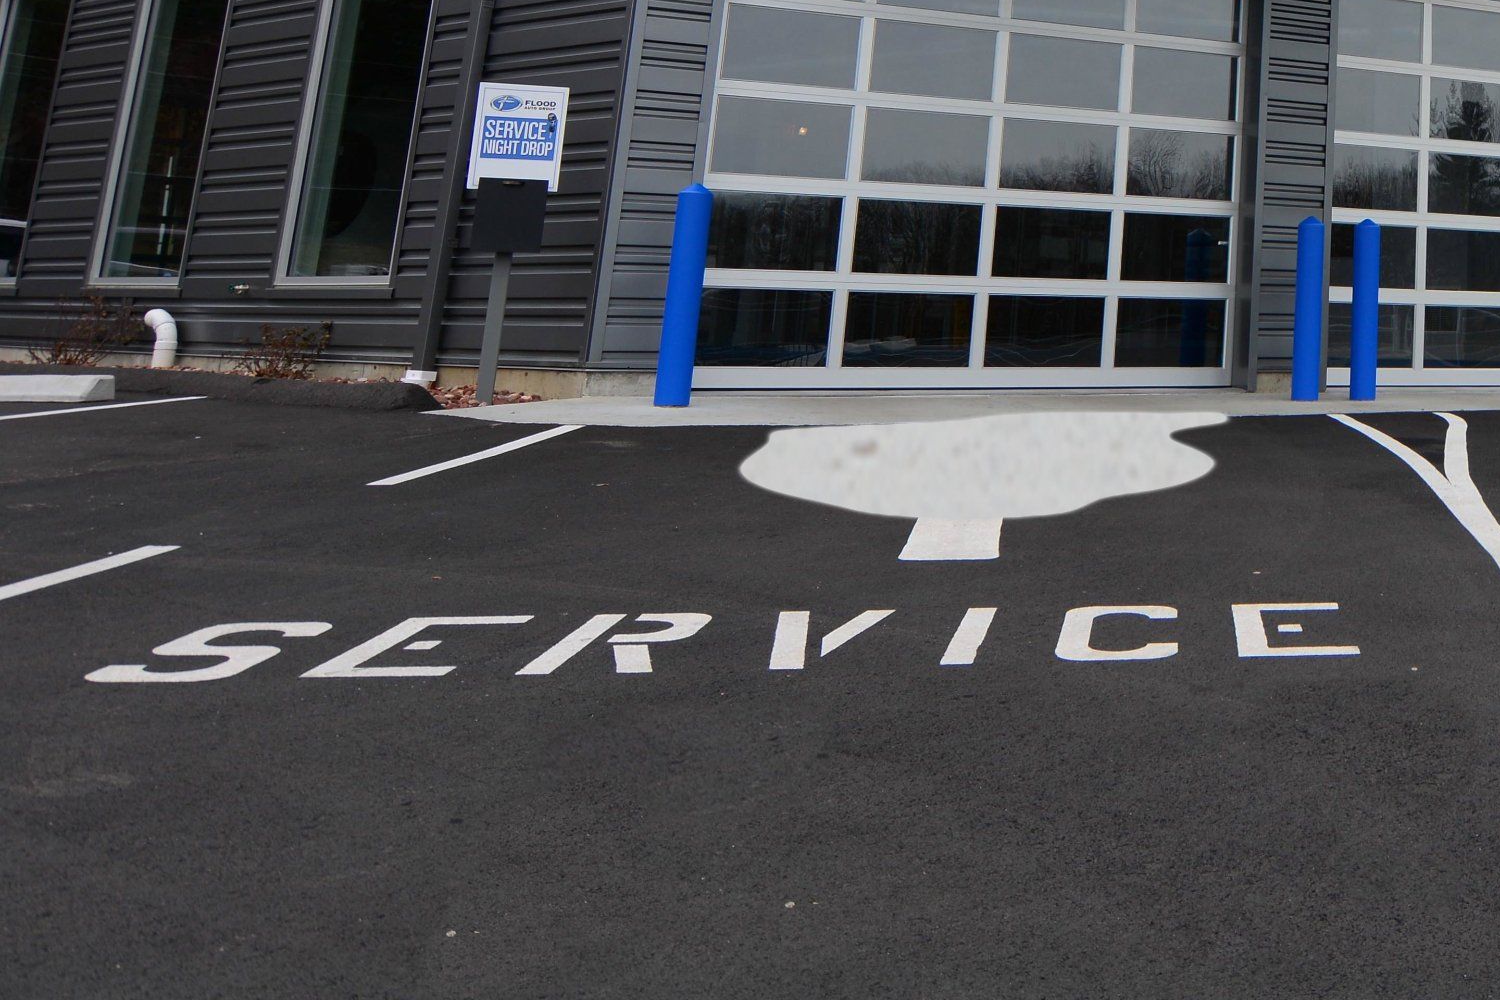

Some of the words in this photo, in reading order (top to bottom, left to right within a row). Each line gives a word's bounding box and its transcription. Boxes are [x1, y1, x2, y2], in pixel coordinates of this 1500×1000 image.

[525, 100, 557, 108] FLOOD
[485, 119, 548, 140] SERVICE
[483, 139, 520, 155] NIGHT
[521, 141, 554, 157] DROP
[84, 602, 1361, 682] SERVICE
